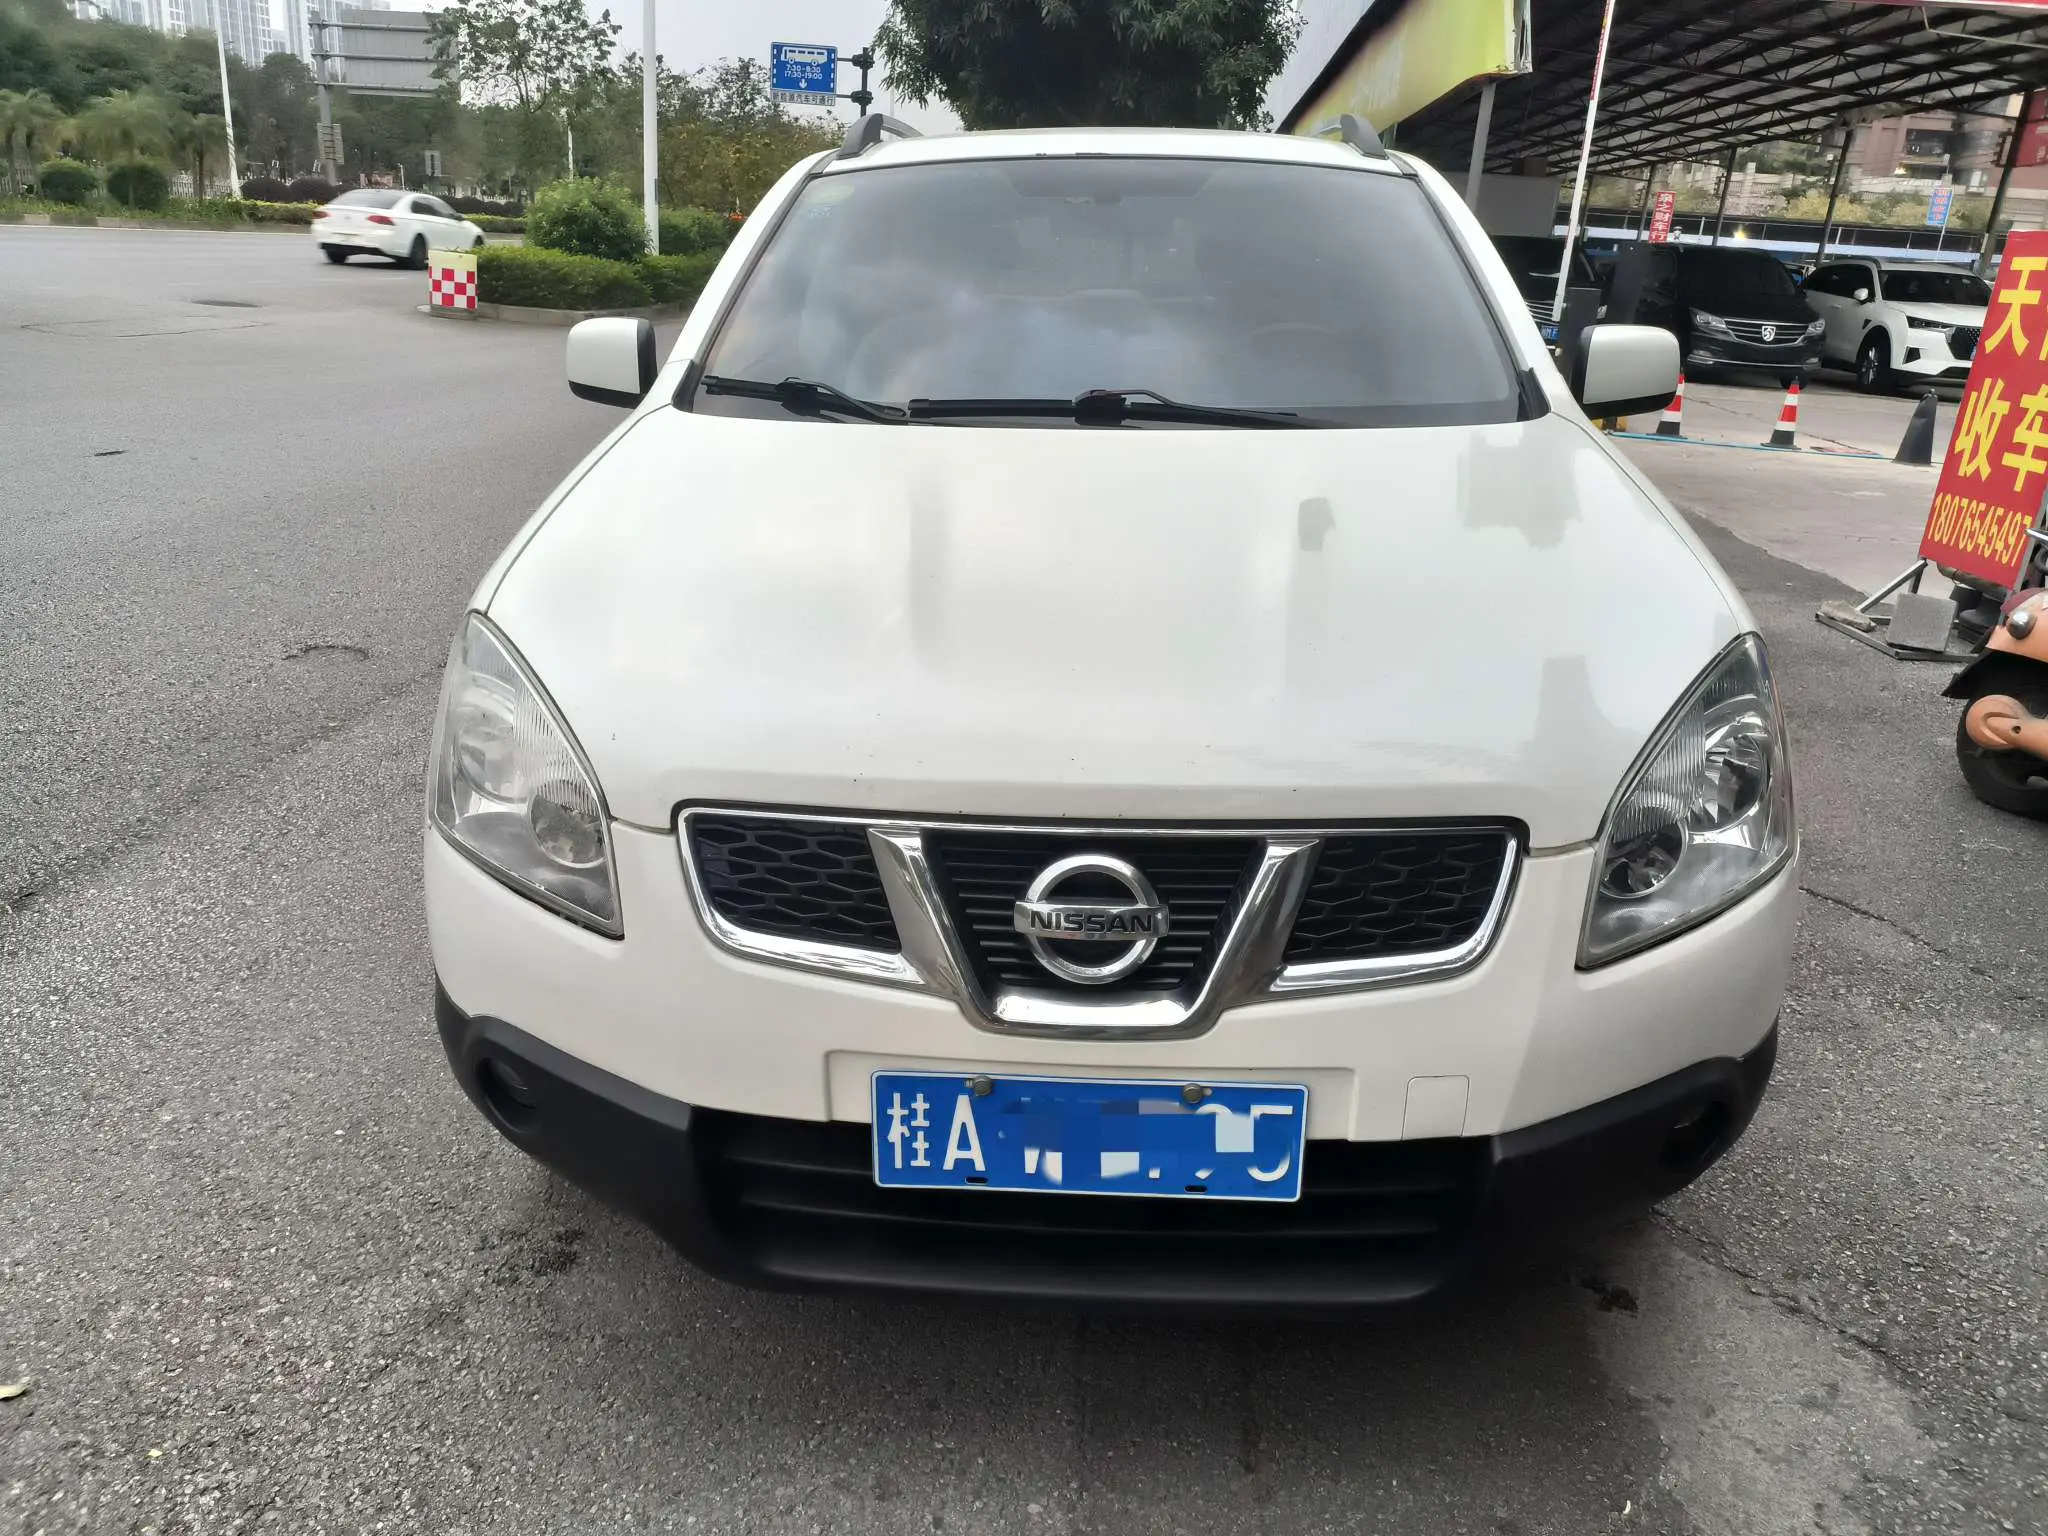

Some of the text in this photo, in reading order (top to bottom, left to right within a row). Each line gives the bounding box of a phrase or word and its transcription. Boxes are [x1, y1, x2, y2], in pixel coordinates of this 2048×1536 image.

[1984, 256, 2048, 361] 天
[1954, 378, 2048, 492] 收车
[1030, 910, 1152, 933] NISSAN
